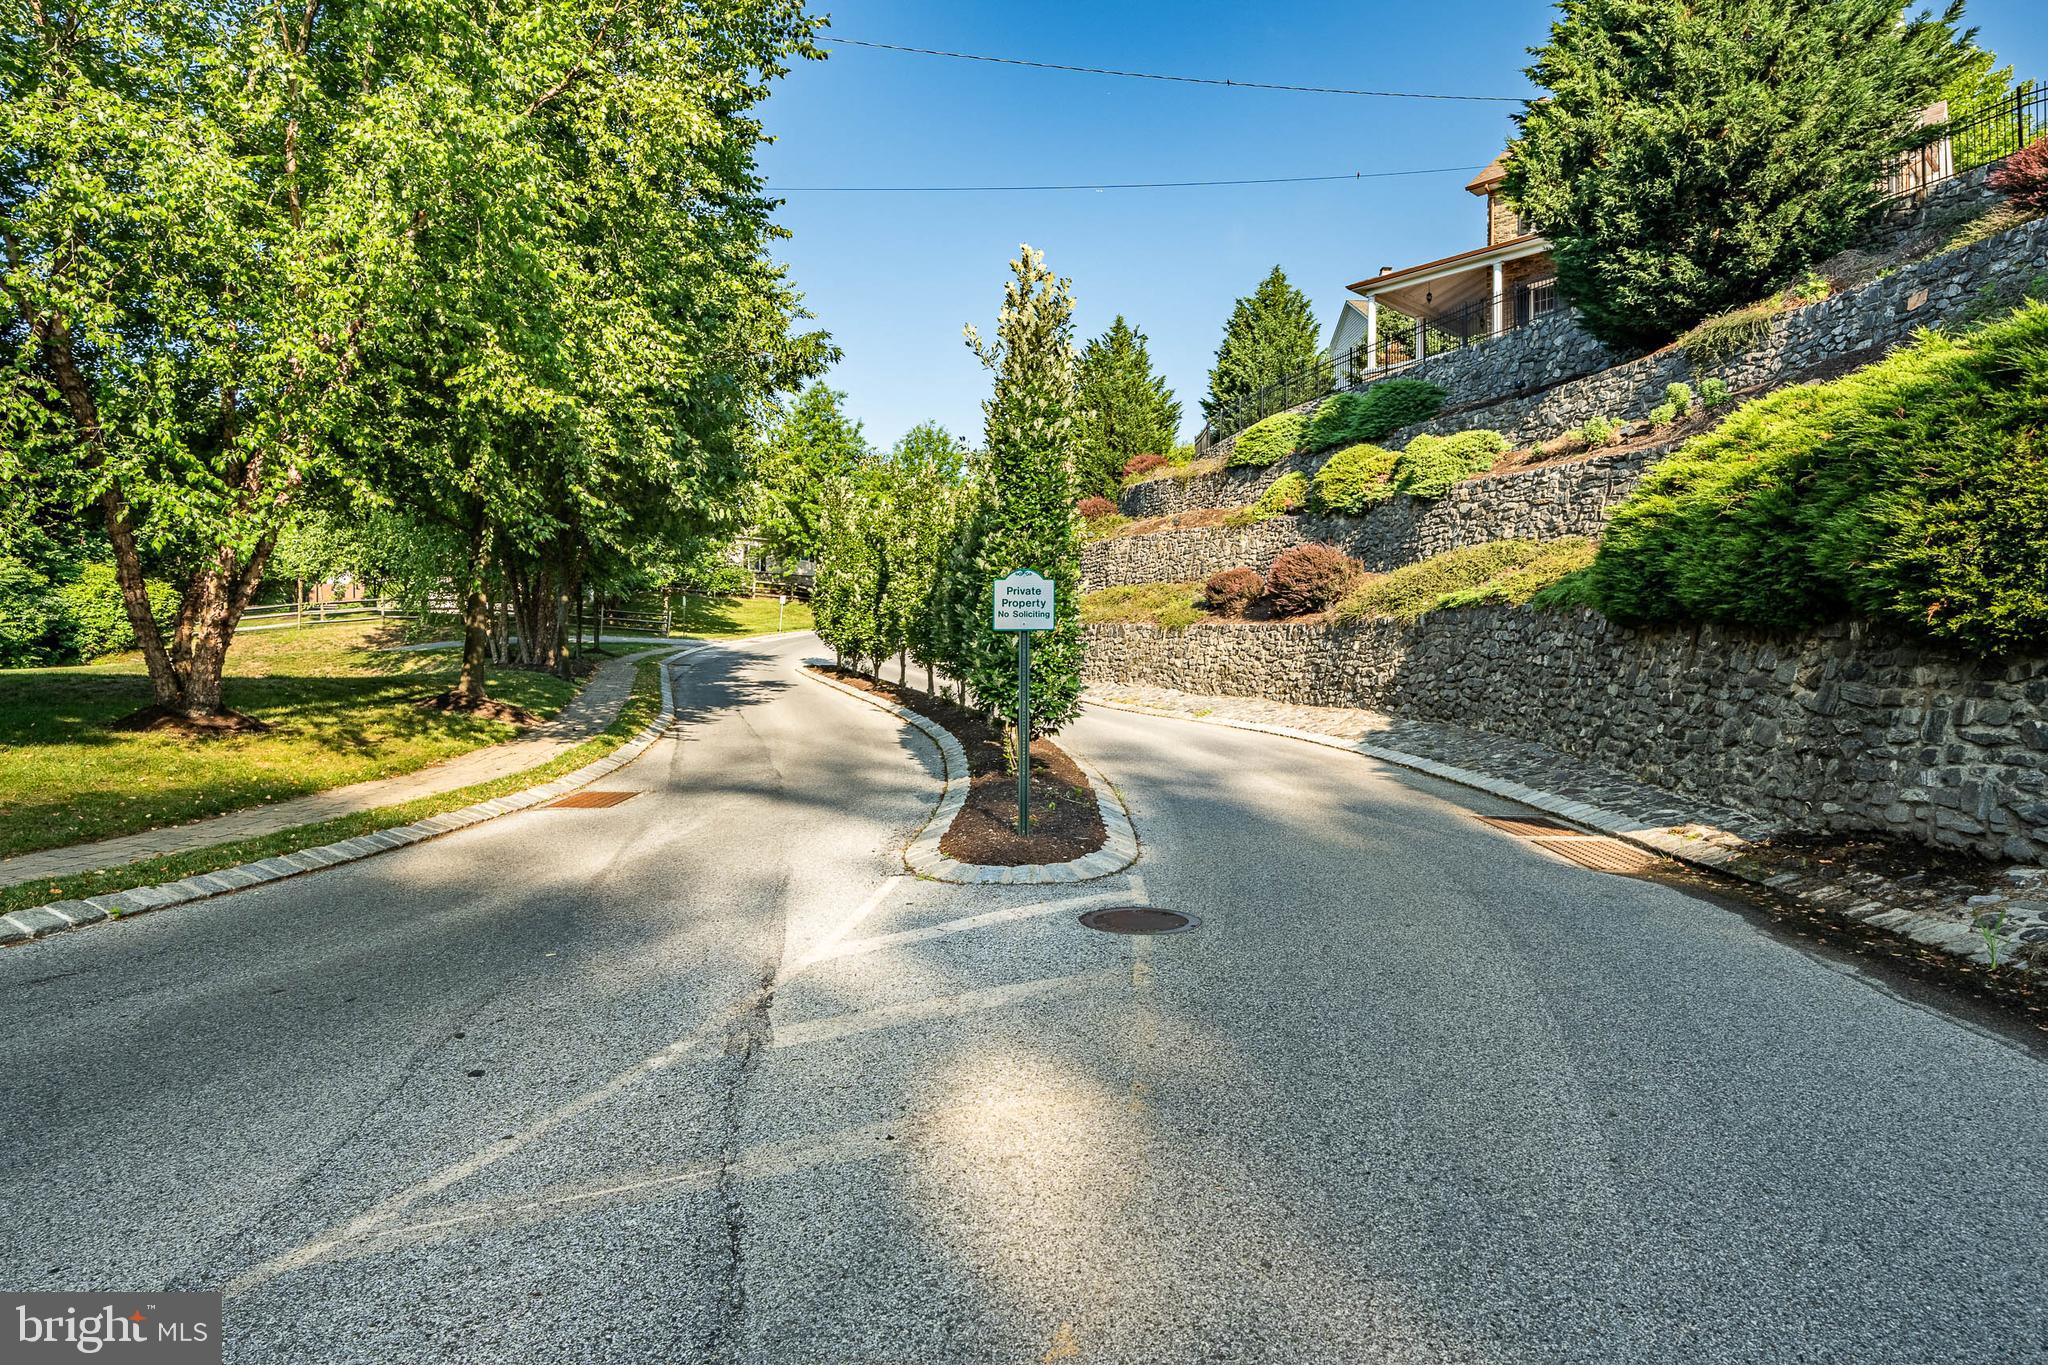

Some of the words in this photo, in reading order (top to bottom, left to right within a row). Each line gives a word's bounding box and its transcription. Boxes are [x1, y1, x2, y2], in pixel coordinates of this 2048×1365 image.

[1006, 586, 1042, 596] Private
[1001, 598, 1047, 610] Property
[998, 610, 1010, 618] No
[1012, 610, 1051, 620] Soliciting
